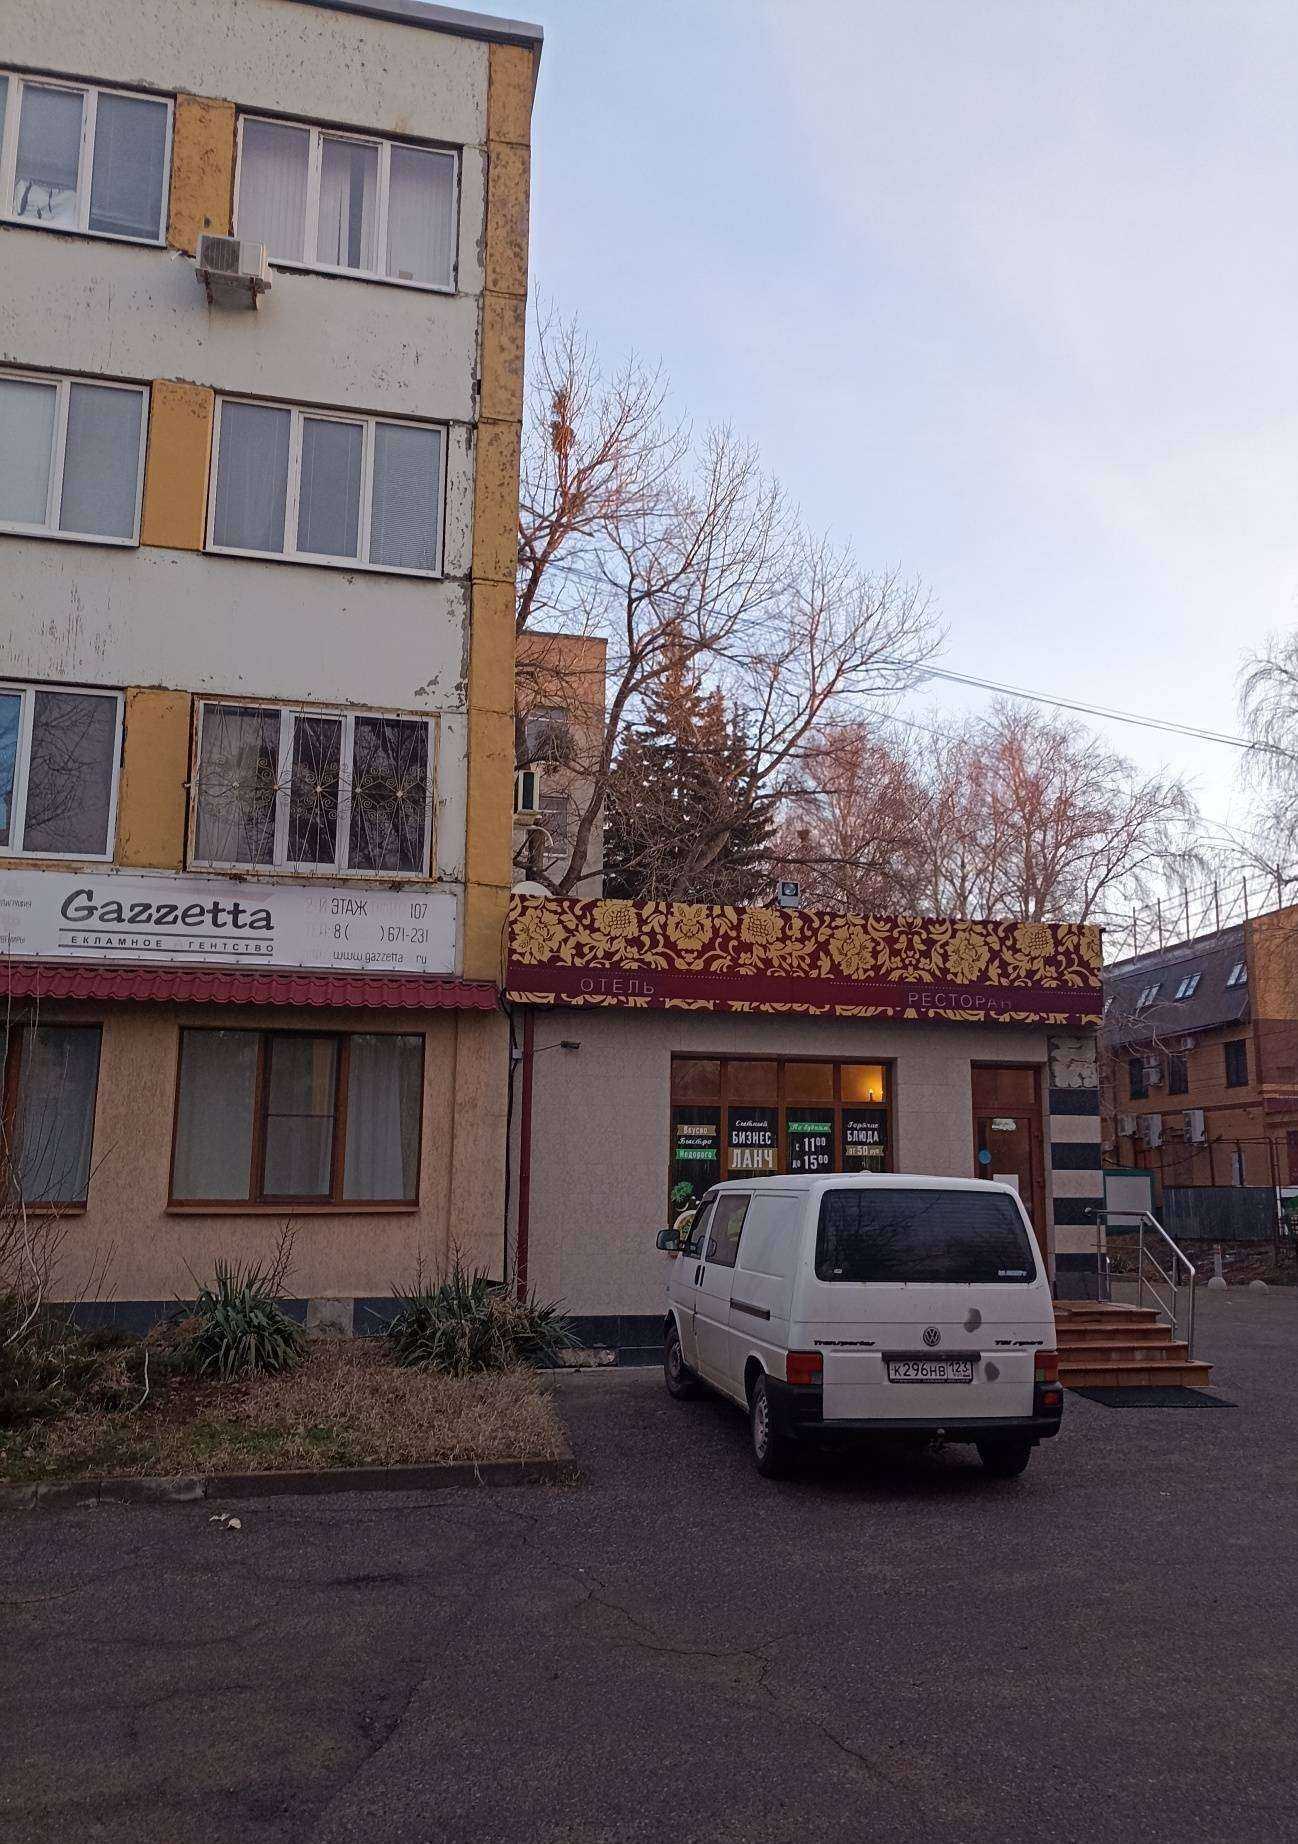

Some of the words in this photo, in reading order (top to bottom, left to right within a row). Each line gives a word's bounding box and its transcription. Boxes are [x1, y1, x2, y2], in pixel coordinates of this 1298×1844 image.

[60, 888, 273, 930] Gazzetta
[330, 897, 368, 917] ЭТАЖ
[409, 903, 428, 919] 107
[60, 935, 162, 949] ЕКЛАМНОЕ
[174, 940, 273, 953] ГЕНТСТВО
[580, 977, 655, 994] ОТЕЛЬ
[683, 1125, 708, 1135] Вкусно
[847, 1130, 879, 1143] БЛЮДА
[678, 1137, 712, 1146] Быстро
[732, 1131, 772, 1145] БИЗНЕС
[679, 1150, 712, 1160] Недорого
[857, 1145, 868, 1155] 50
[731, 1149, 773, 1168] ЛАНЧ
